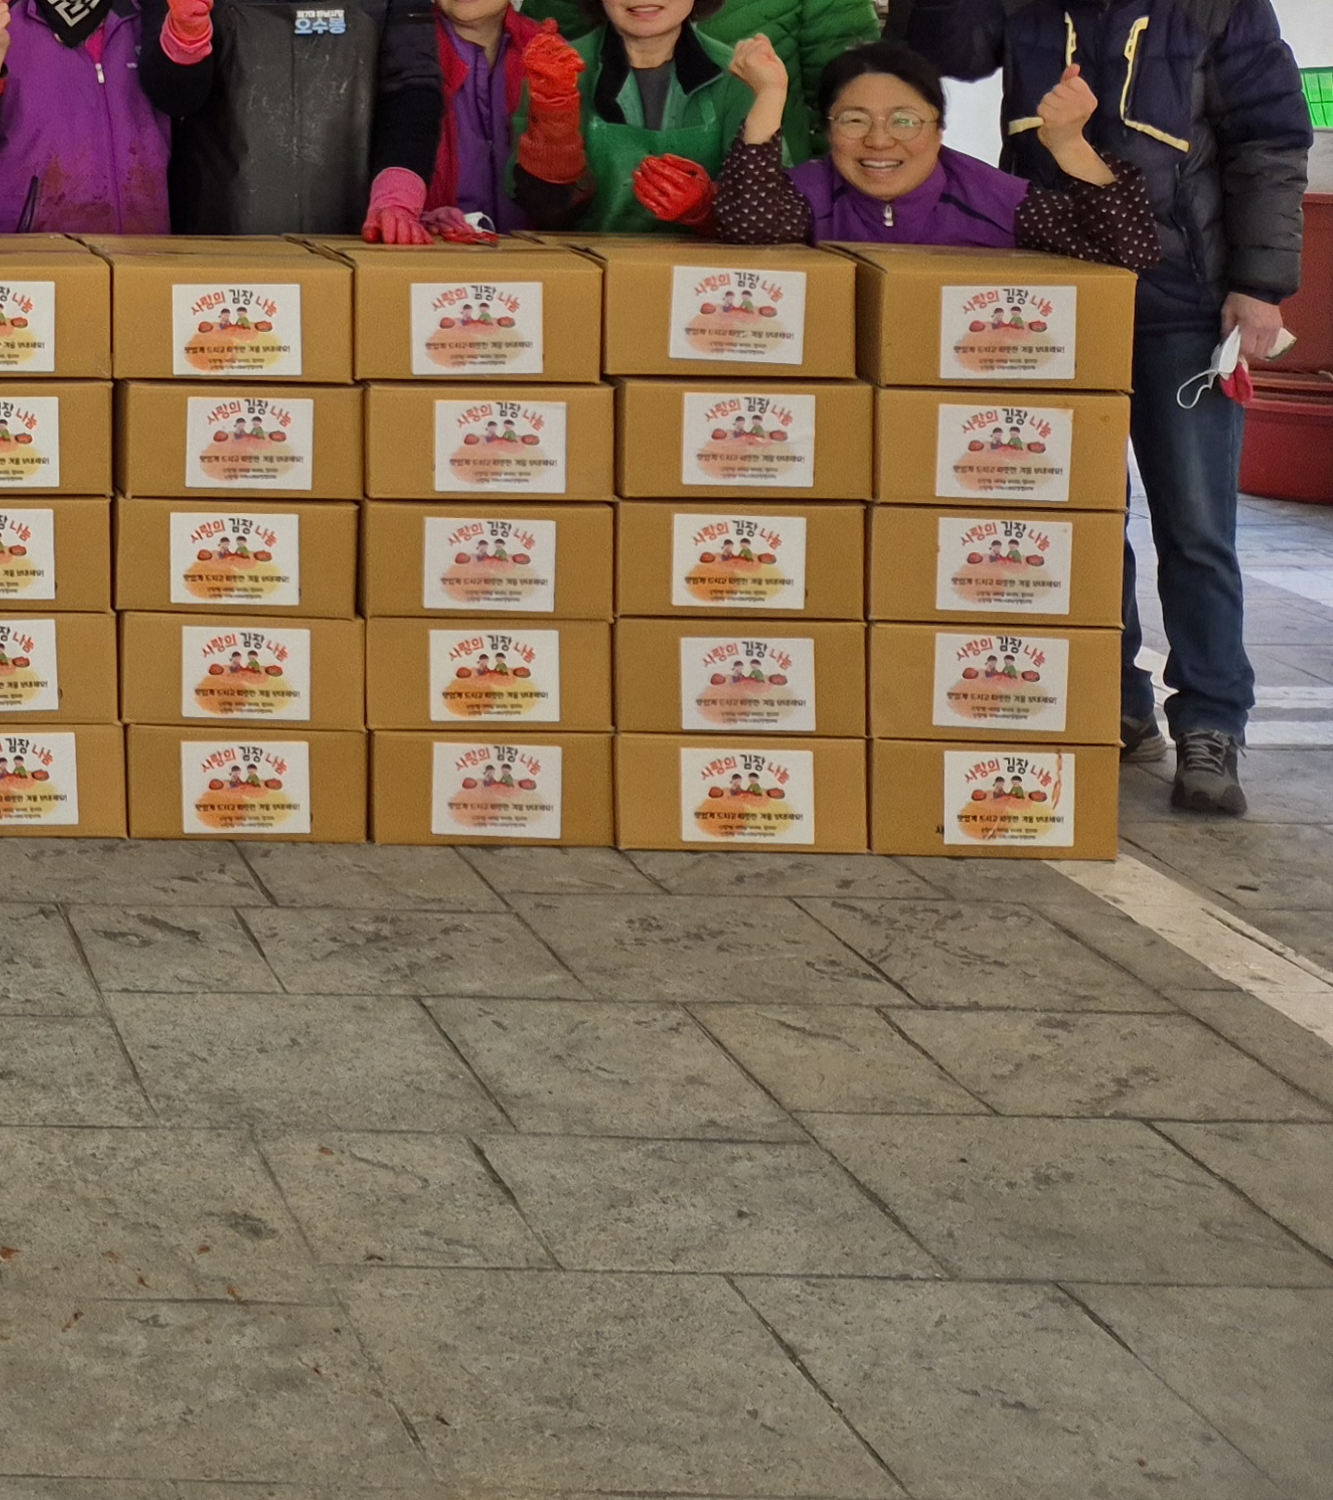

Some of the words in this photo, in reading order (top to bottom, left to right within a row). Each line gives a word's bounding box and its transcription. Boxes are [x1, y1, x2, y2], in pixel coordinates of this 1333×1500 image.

[11, 292, 33, 314] 나눔
[432, 286, 468, 312] 사랑의
[470, 284, 496, 302] 김장
[497, 292, 520, 314] 나눔
[207, 400, 242, 425] 사랑의
[244, 398, 269, 416] 김장
[270, 406, 291, 428] 나눔
[705, 398, 741, 422] 사랑의
[744, 396, 770, 414] 김장
[771, 404, 793, 427] 나눔
[9, 520, 31, 542] 나눔
[202, 634, 237, 658] 사랑의
[239, 632, 265, 650] 김장
[266, 640, 288, 663] 나눔
[703, 642, 739, 668] 사랑의
[741, 641, 768, 658] 김장
[769, 648, 792, 671] 나눔
[5, 737, 30, 755] 김장
[31, 744, 53, 767] 나눔
[965, 758, 1001, 784] 사랑의
[1003, 757, 1029, 775] 김장
[1030, 765, 1052, 788] 나눔
